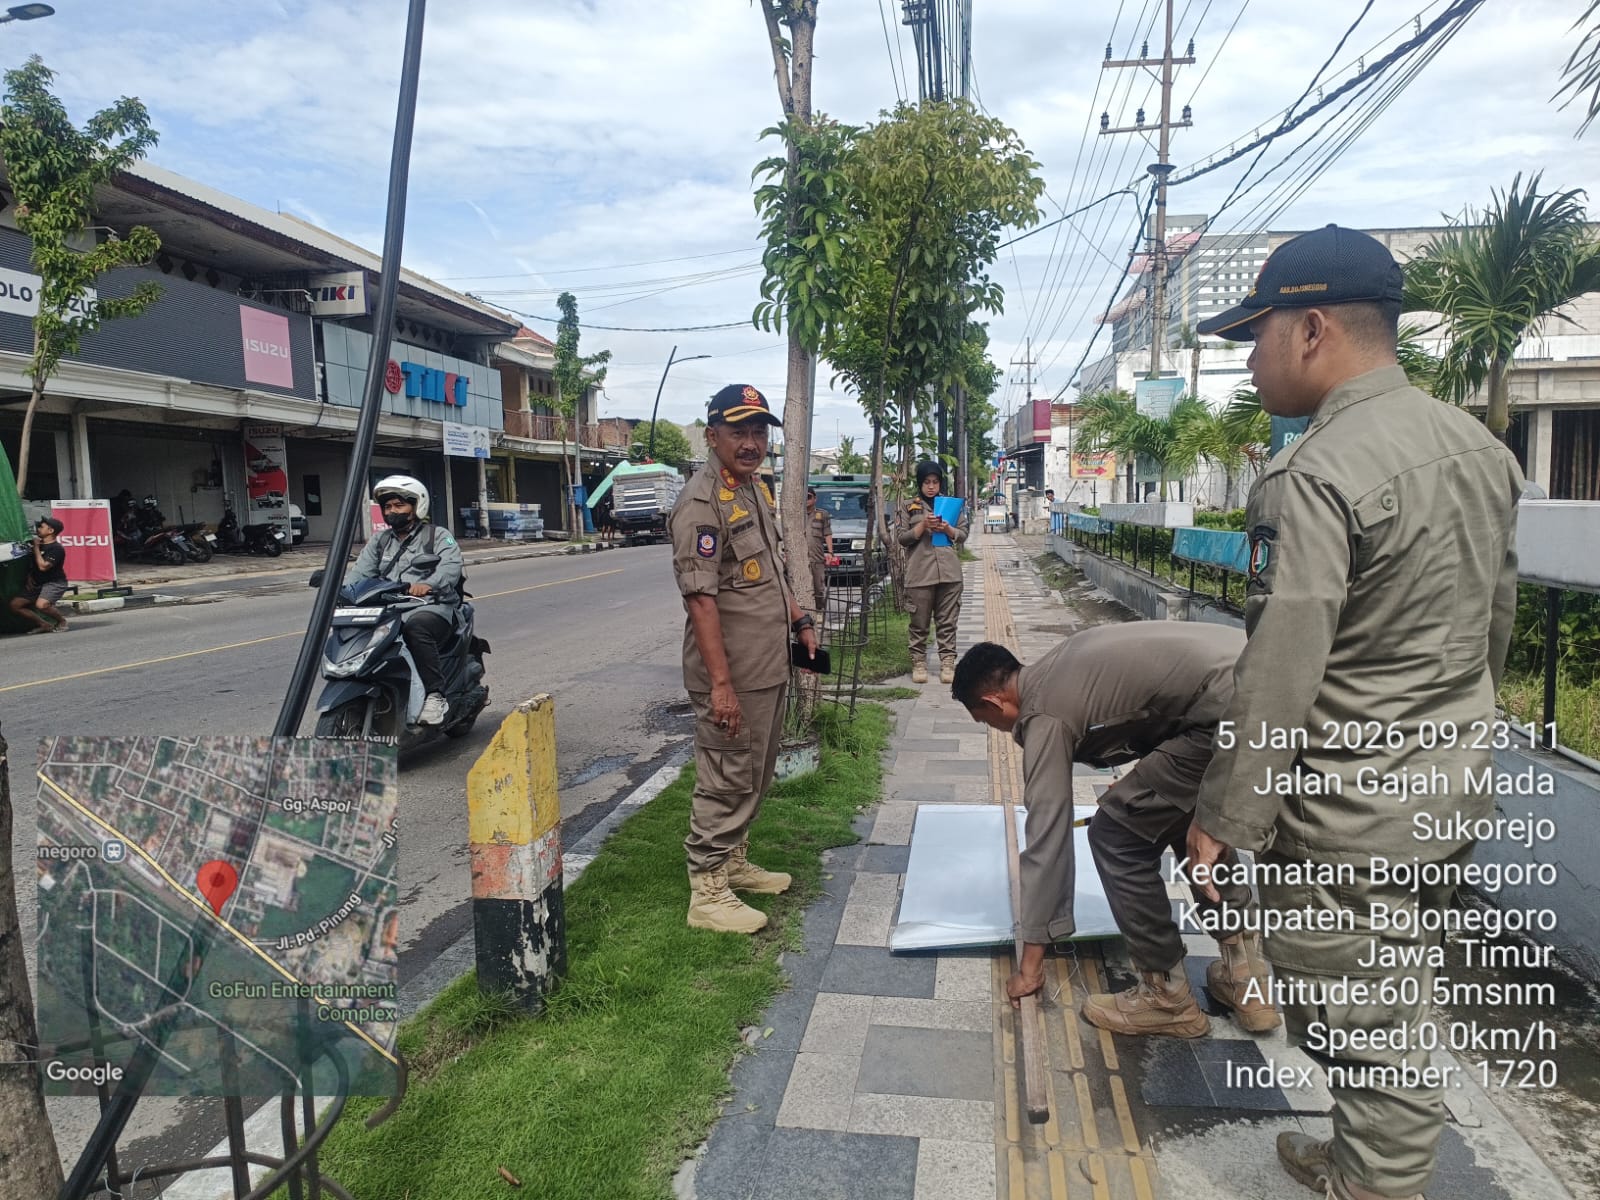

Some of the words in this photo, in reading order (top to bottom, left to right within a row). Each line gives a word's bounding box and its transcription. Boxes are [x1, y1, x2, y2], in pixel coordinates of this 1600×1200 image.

[310, 285, 355, 302] TIKI
[245, 338, 289, 359] ISUZU
[401, 361, 468, 407] TIKI
[56, 535, 109, 547] ISUZU
